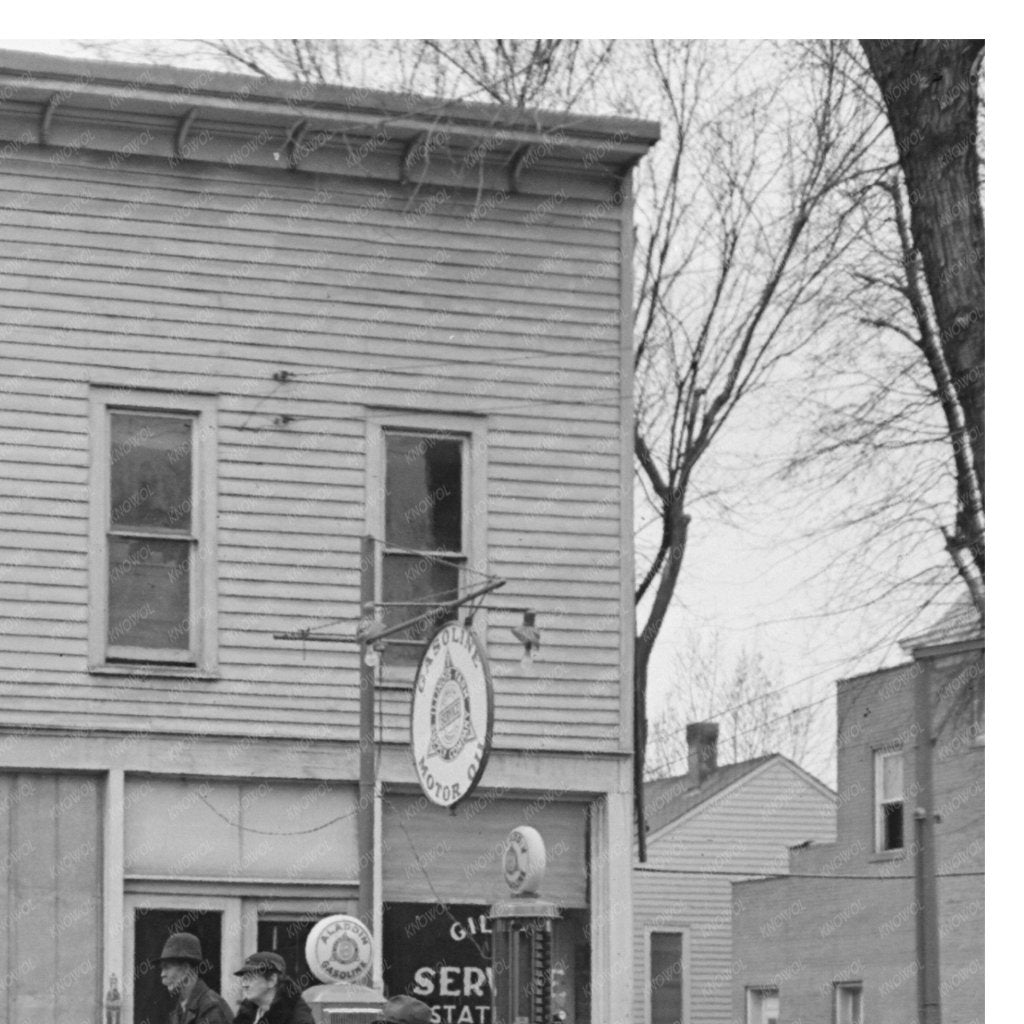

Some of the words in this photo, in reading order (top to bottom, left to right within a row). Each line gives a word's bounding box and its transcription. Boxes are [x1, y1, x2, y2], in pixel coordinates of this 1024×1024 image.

[419, 756, 461, 801] MOTOR
[320, 922, 369, 945] ALADDIN
[450, 914, 493, 940] GIL
[430, 1004, 492, 1024] STAT
